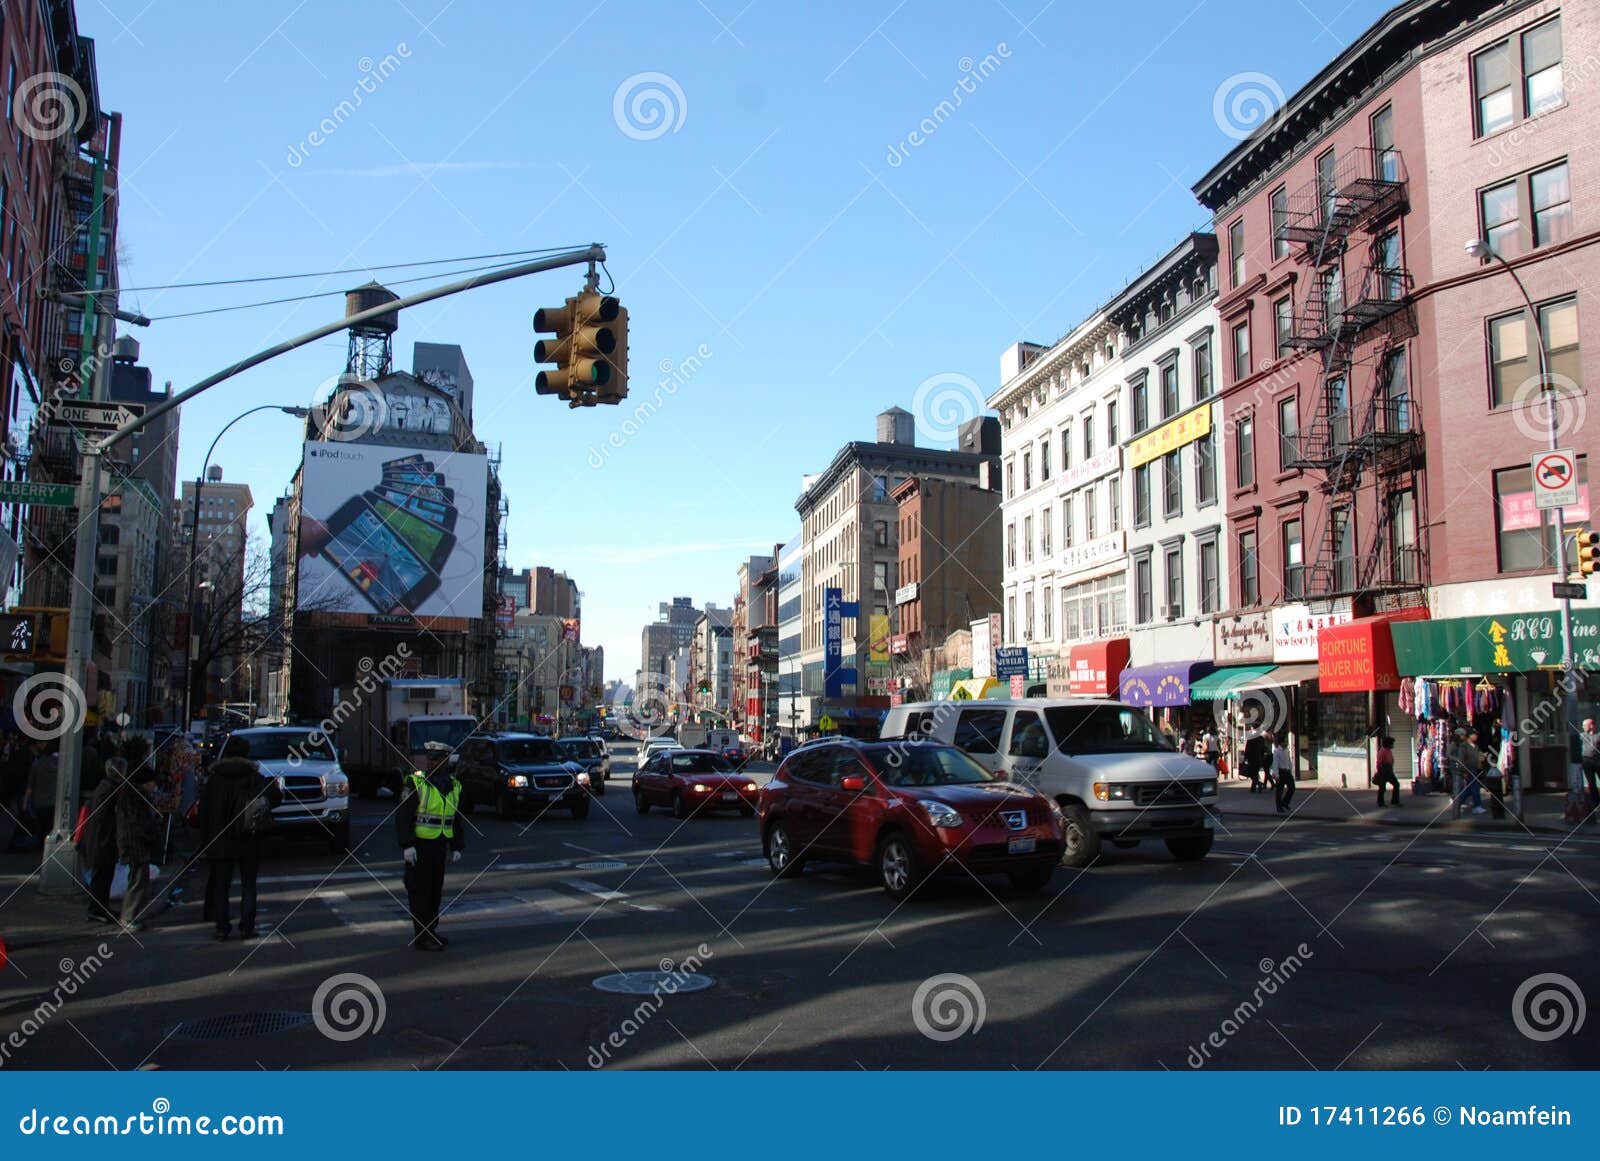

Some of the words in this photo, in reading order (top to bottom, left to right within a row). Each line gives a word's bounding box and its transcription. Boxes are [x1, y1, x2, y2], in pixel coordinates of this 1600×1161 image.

[62, 408, 90, 420] ONE
[102, 410, 130, 425] WAY
[319, 449, 339, 459] iPod
[341, 450, 364, 460] touch
[0, 482, 57, 497] LBERRY
[828, 594, 841, 656] 大通銀行
[1275, 638, 1289, 647] NEW
[1321, 637, 1367, 657] FORTUNE
[1319, 660, 1352, 677] SILVER
[1354, 658, 1373, 674] INC.
